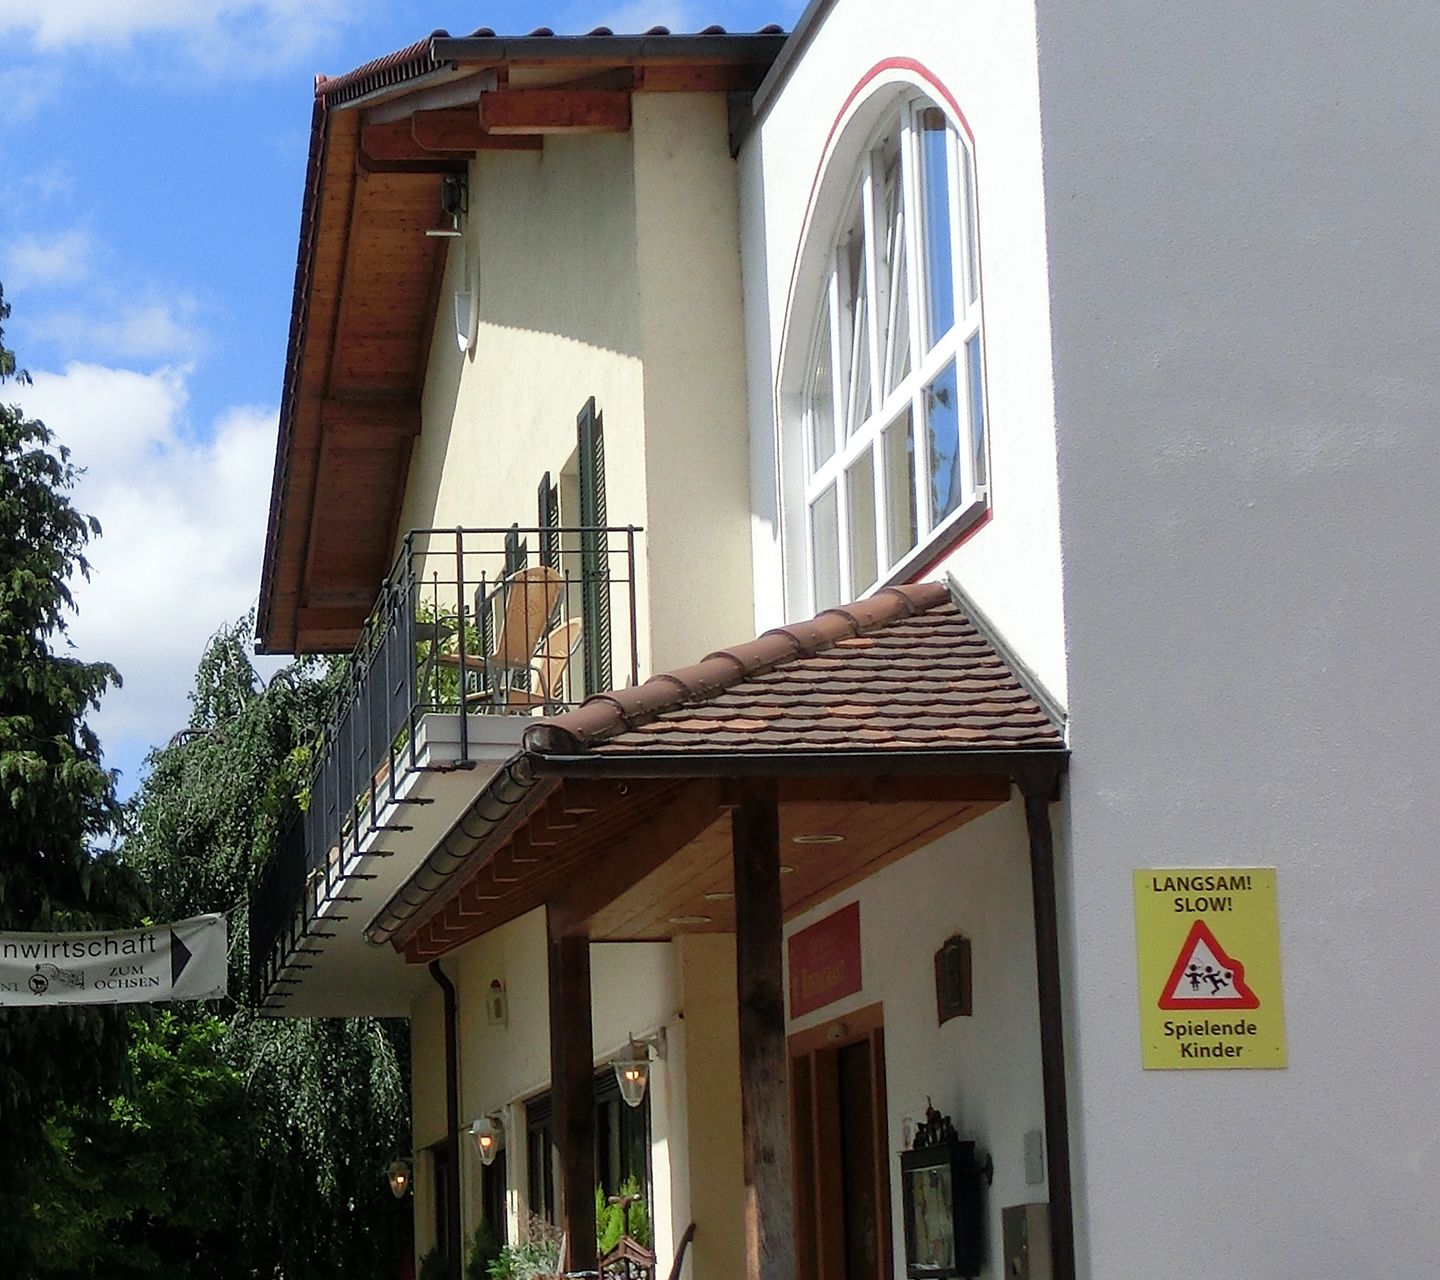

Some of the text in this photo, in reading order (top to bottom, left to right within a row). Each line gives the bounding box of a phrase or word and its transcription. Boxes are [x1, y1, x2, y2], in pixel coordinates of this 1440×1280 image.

[1152, 875, 1252, 892] LANGSAM!
[1174, 897, 1233, 913] SLOW!
[109, 965, 144, 977] ZUM
[94, 976, 160, 990] OCHSEN
[1163, 1019, 1257, 1040] Spielende
[1180, 1042, 1243, 1058] Kinder
